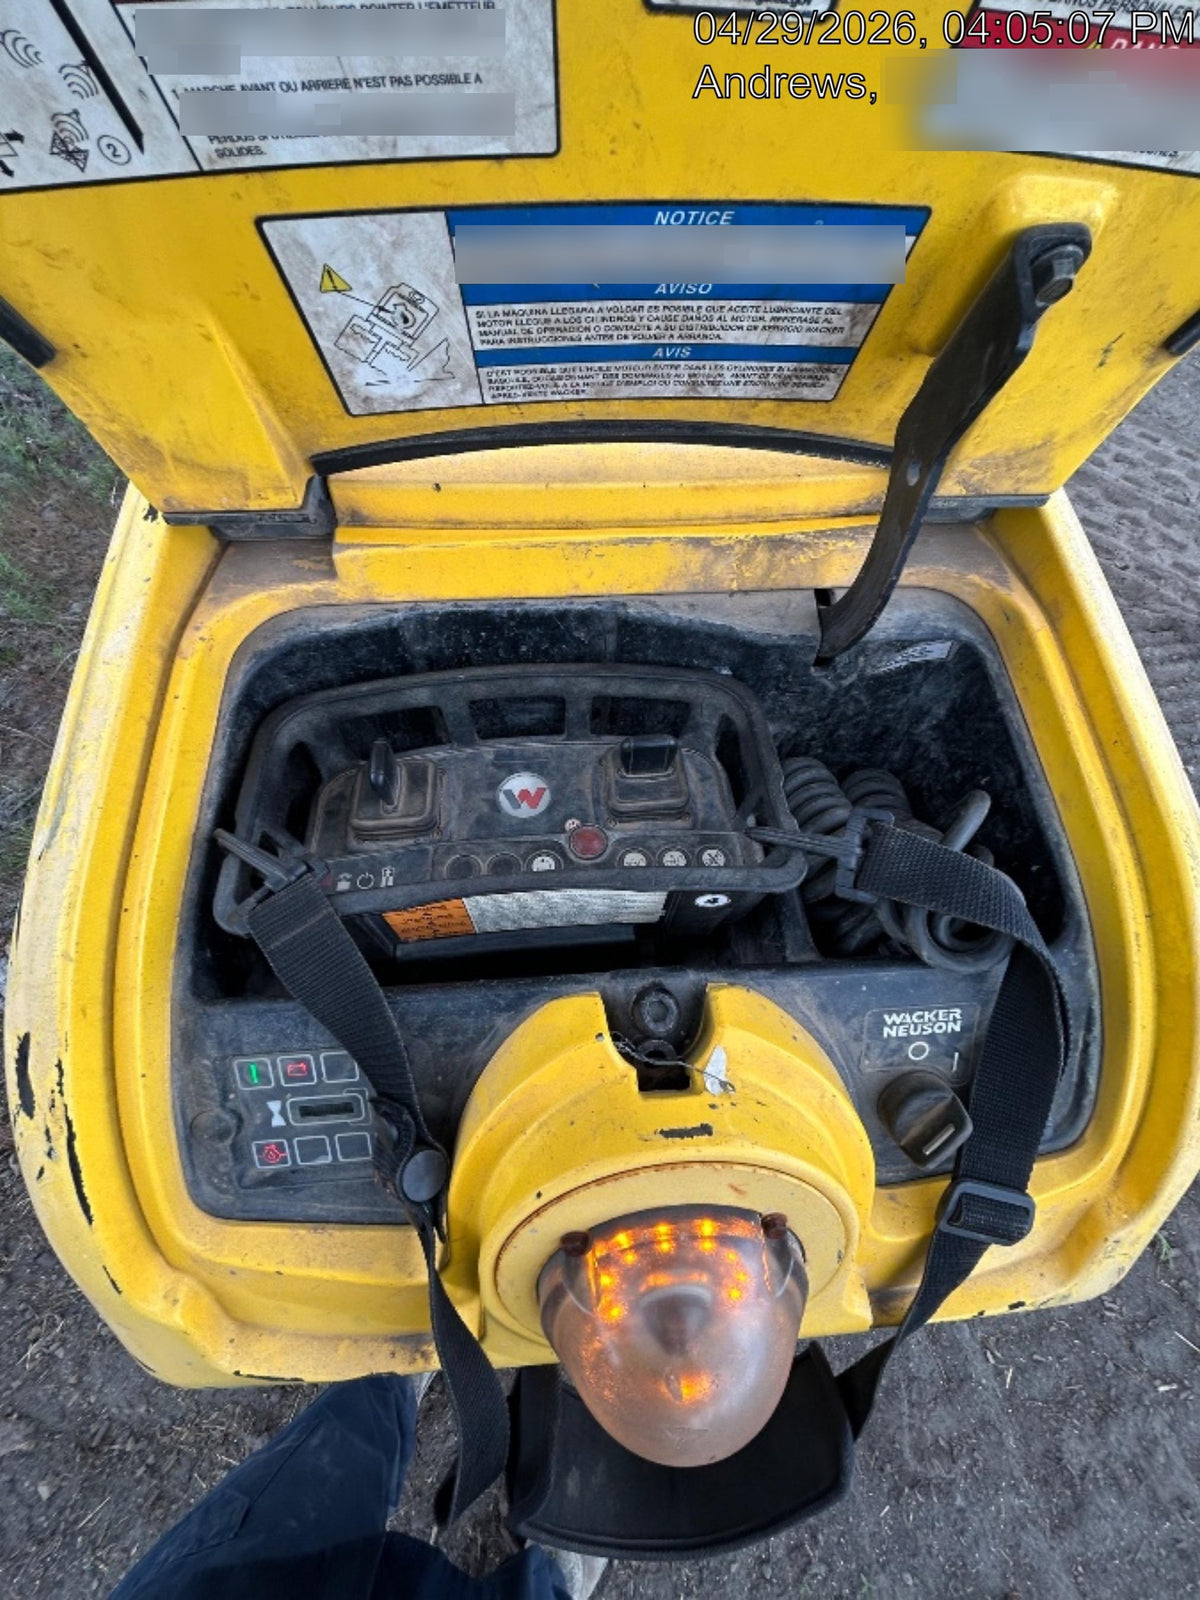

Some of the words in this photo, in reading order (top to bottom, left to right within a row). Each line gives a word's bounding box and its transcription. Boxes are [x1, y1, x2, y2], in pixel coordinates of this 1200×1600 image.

[390, 75, 413, 87] PAS
[415, 73, 472, 86] POSSIBLE
[107, 143, 121, 158] 2
[654, 210, 735, 226] NOTICE
[654, 283, 713, 295] AVISO
[653, 346, 692, 359] AVIS
[883, 1008, 962, 1025] WACKER
[883, 1020, 962, 1038] NEUSON
